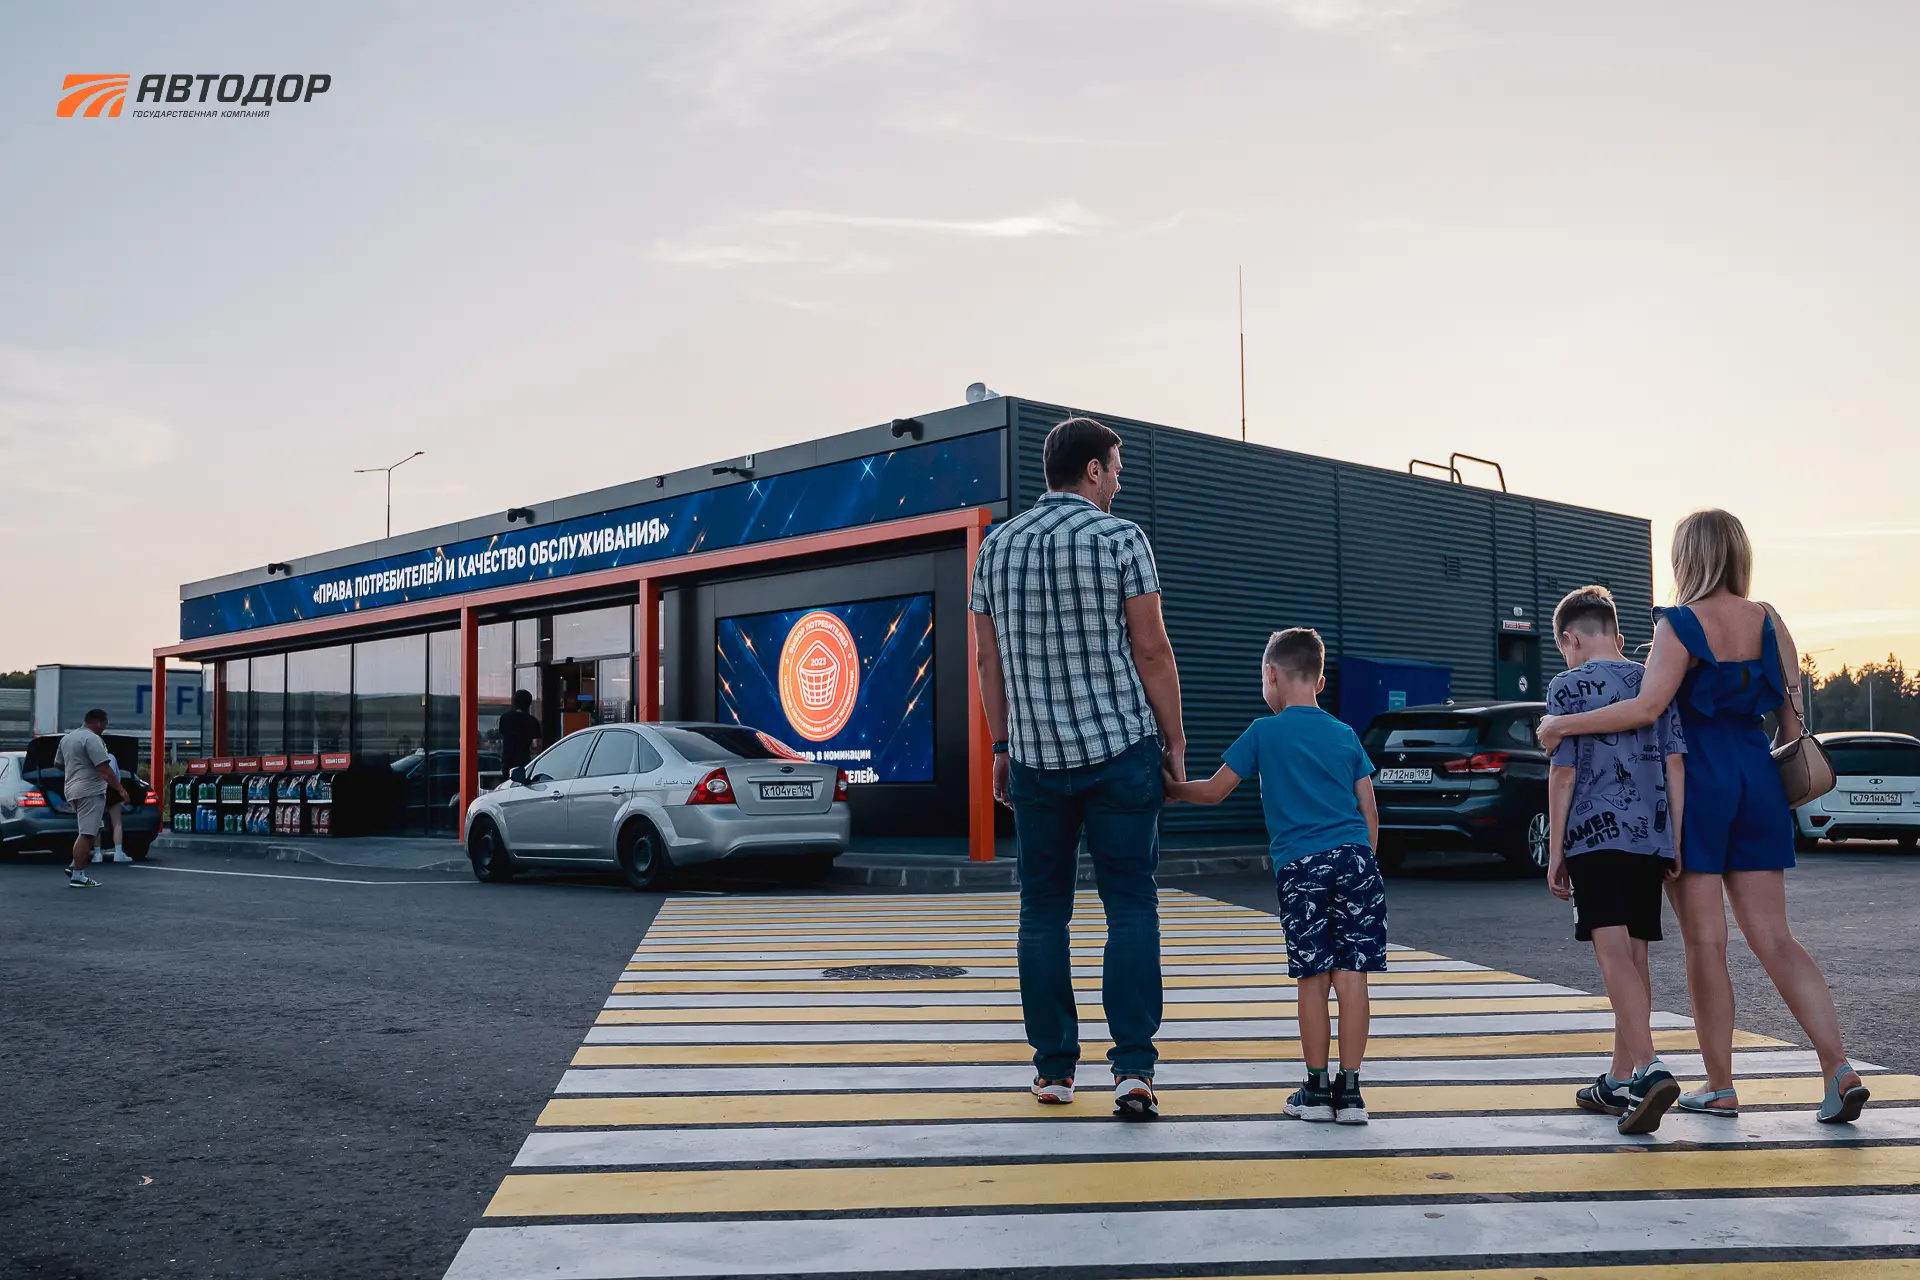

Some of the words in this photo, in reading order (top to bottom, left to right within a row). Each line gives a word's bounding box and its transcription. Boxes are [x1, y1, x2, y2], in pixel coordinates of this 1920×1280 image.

[313, 579, 352, 604] «ПРАВА
[355, 556, 443, 597] ПОТРЕБИТЕЛЕЙ
[445, 559, 455, 580] И
[458, 545, 526, 578] КАЧЕСТВО
[529, 517, 670, 566] ОБСЛУЖИВАНИЯ»
[810, 657, 827, 667] 2023
[1554, 680, 1606, 707] PLAY
